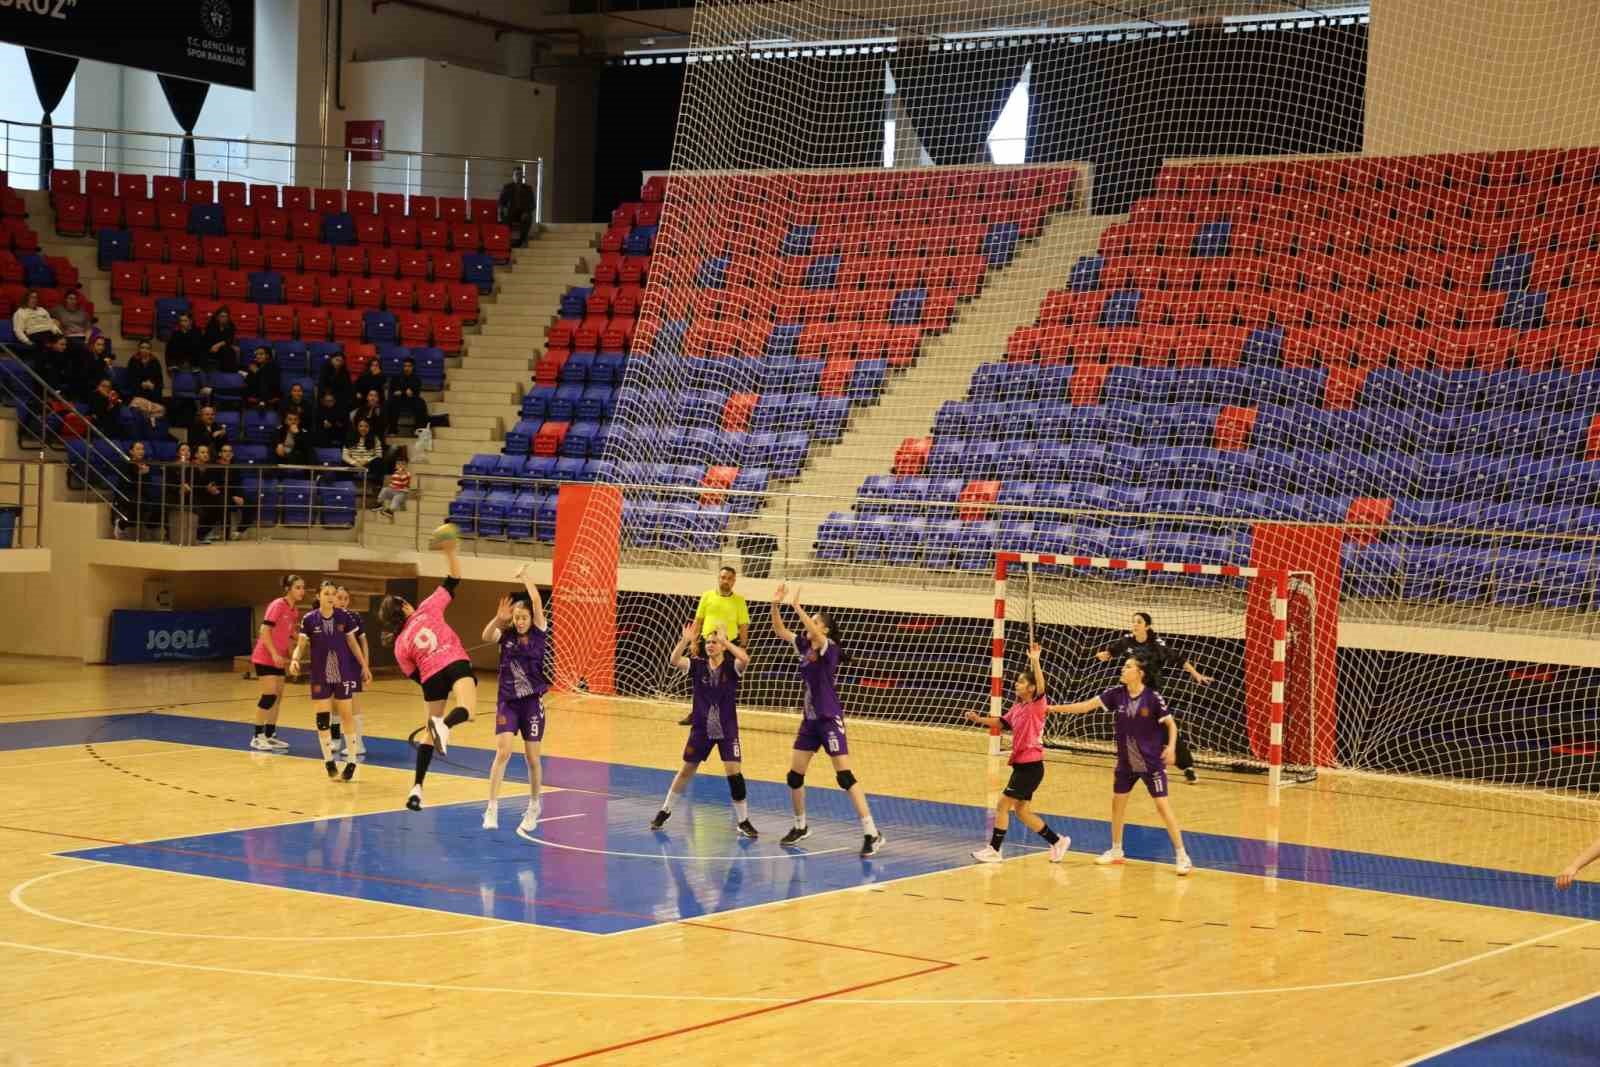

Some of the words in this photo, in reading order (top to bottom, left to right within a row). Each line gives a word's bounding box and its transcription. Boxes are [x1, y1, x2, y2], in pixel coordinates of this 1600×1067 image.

[146, 629, 209, 650] JOOLA
[414, 626, 438, 653] 9
[530, 723, 539, 737] 9
[828, 738, 840, 752] 10
